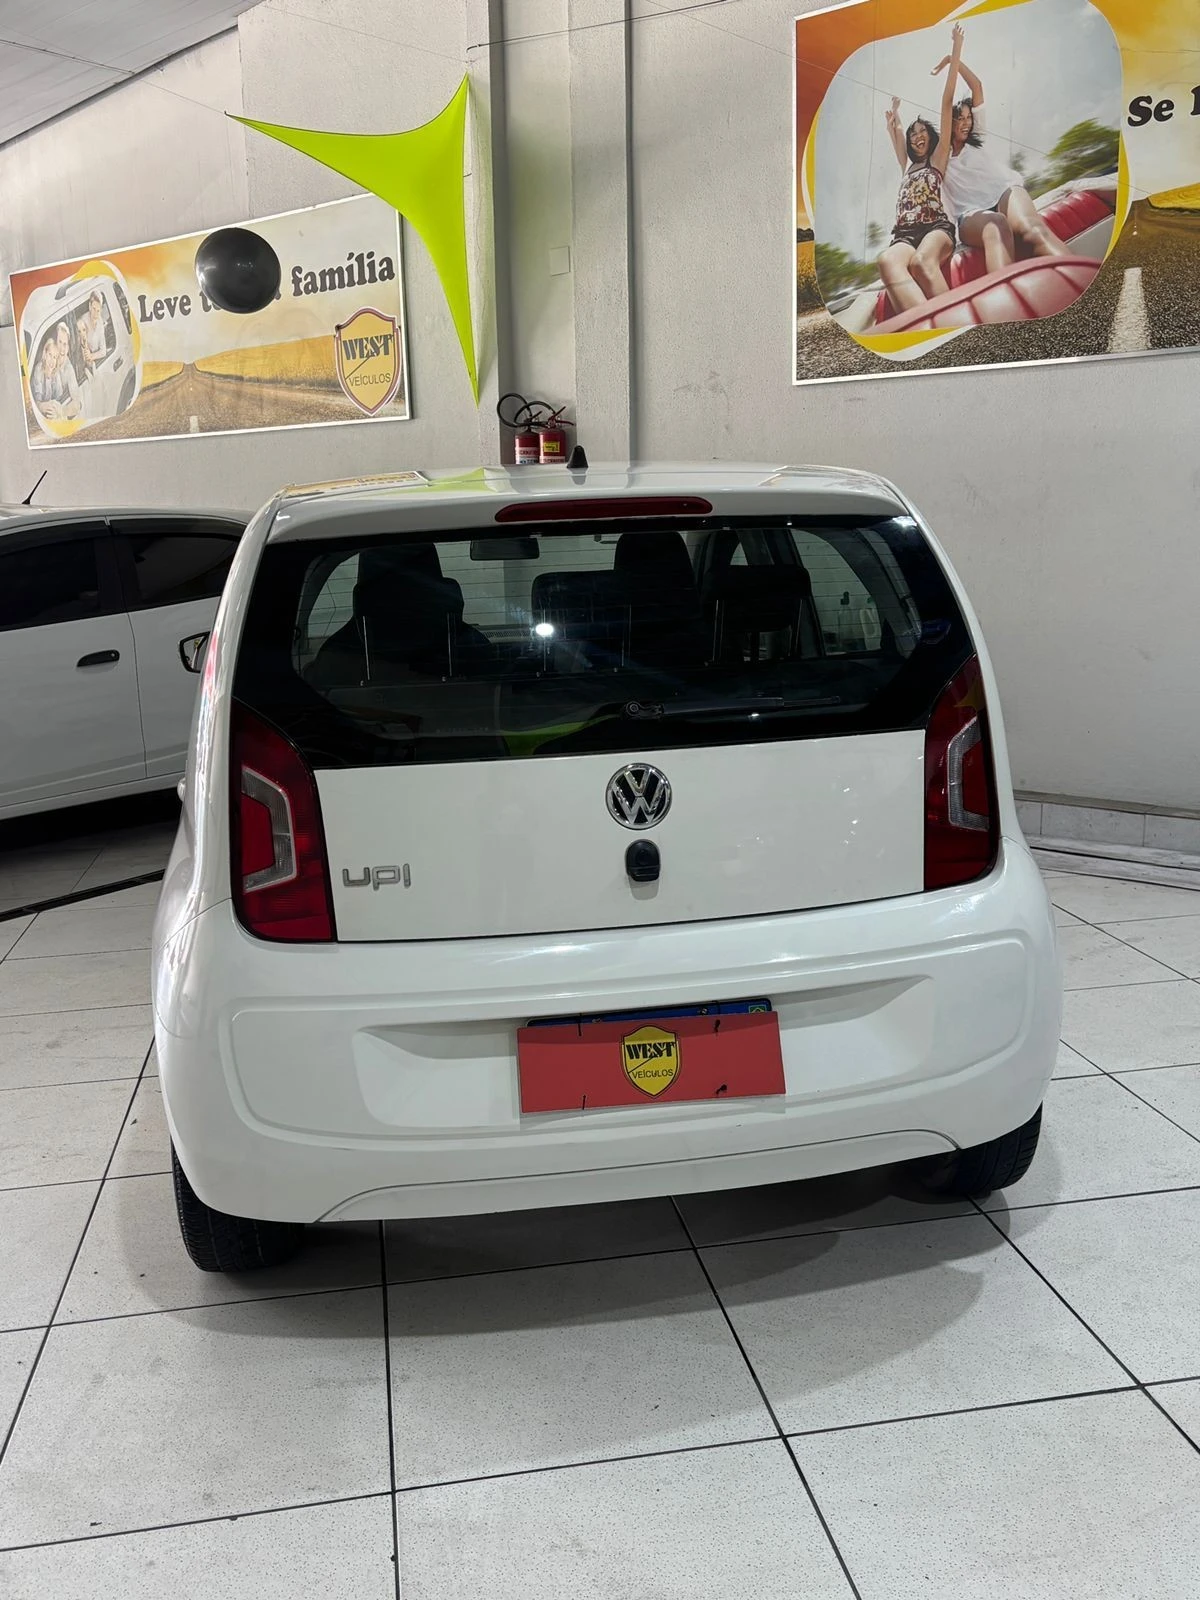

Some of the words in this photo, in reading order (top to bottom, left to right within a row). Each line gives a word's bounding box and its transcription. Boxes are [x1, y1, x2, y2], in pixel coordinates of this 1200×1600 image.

[1127, 95, 1175, 127] Se
[137, 294, 192, 323] Leve
[291, 251, 395, 297] família
[342, 334, 394, 361] WEST
[348, 372, 391, 387] VEÍCULOS
[625, 1041, 675, 1060] WEST
[631, 1068, 674, 1079] VEÍCULOS
